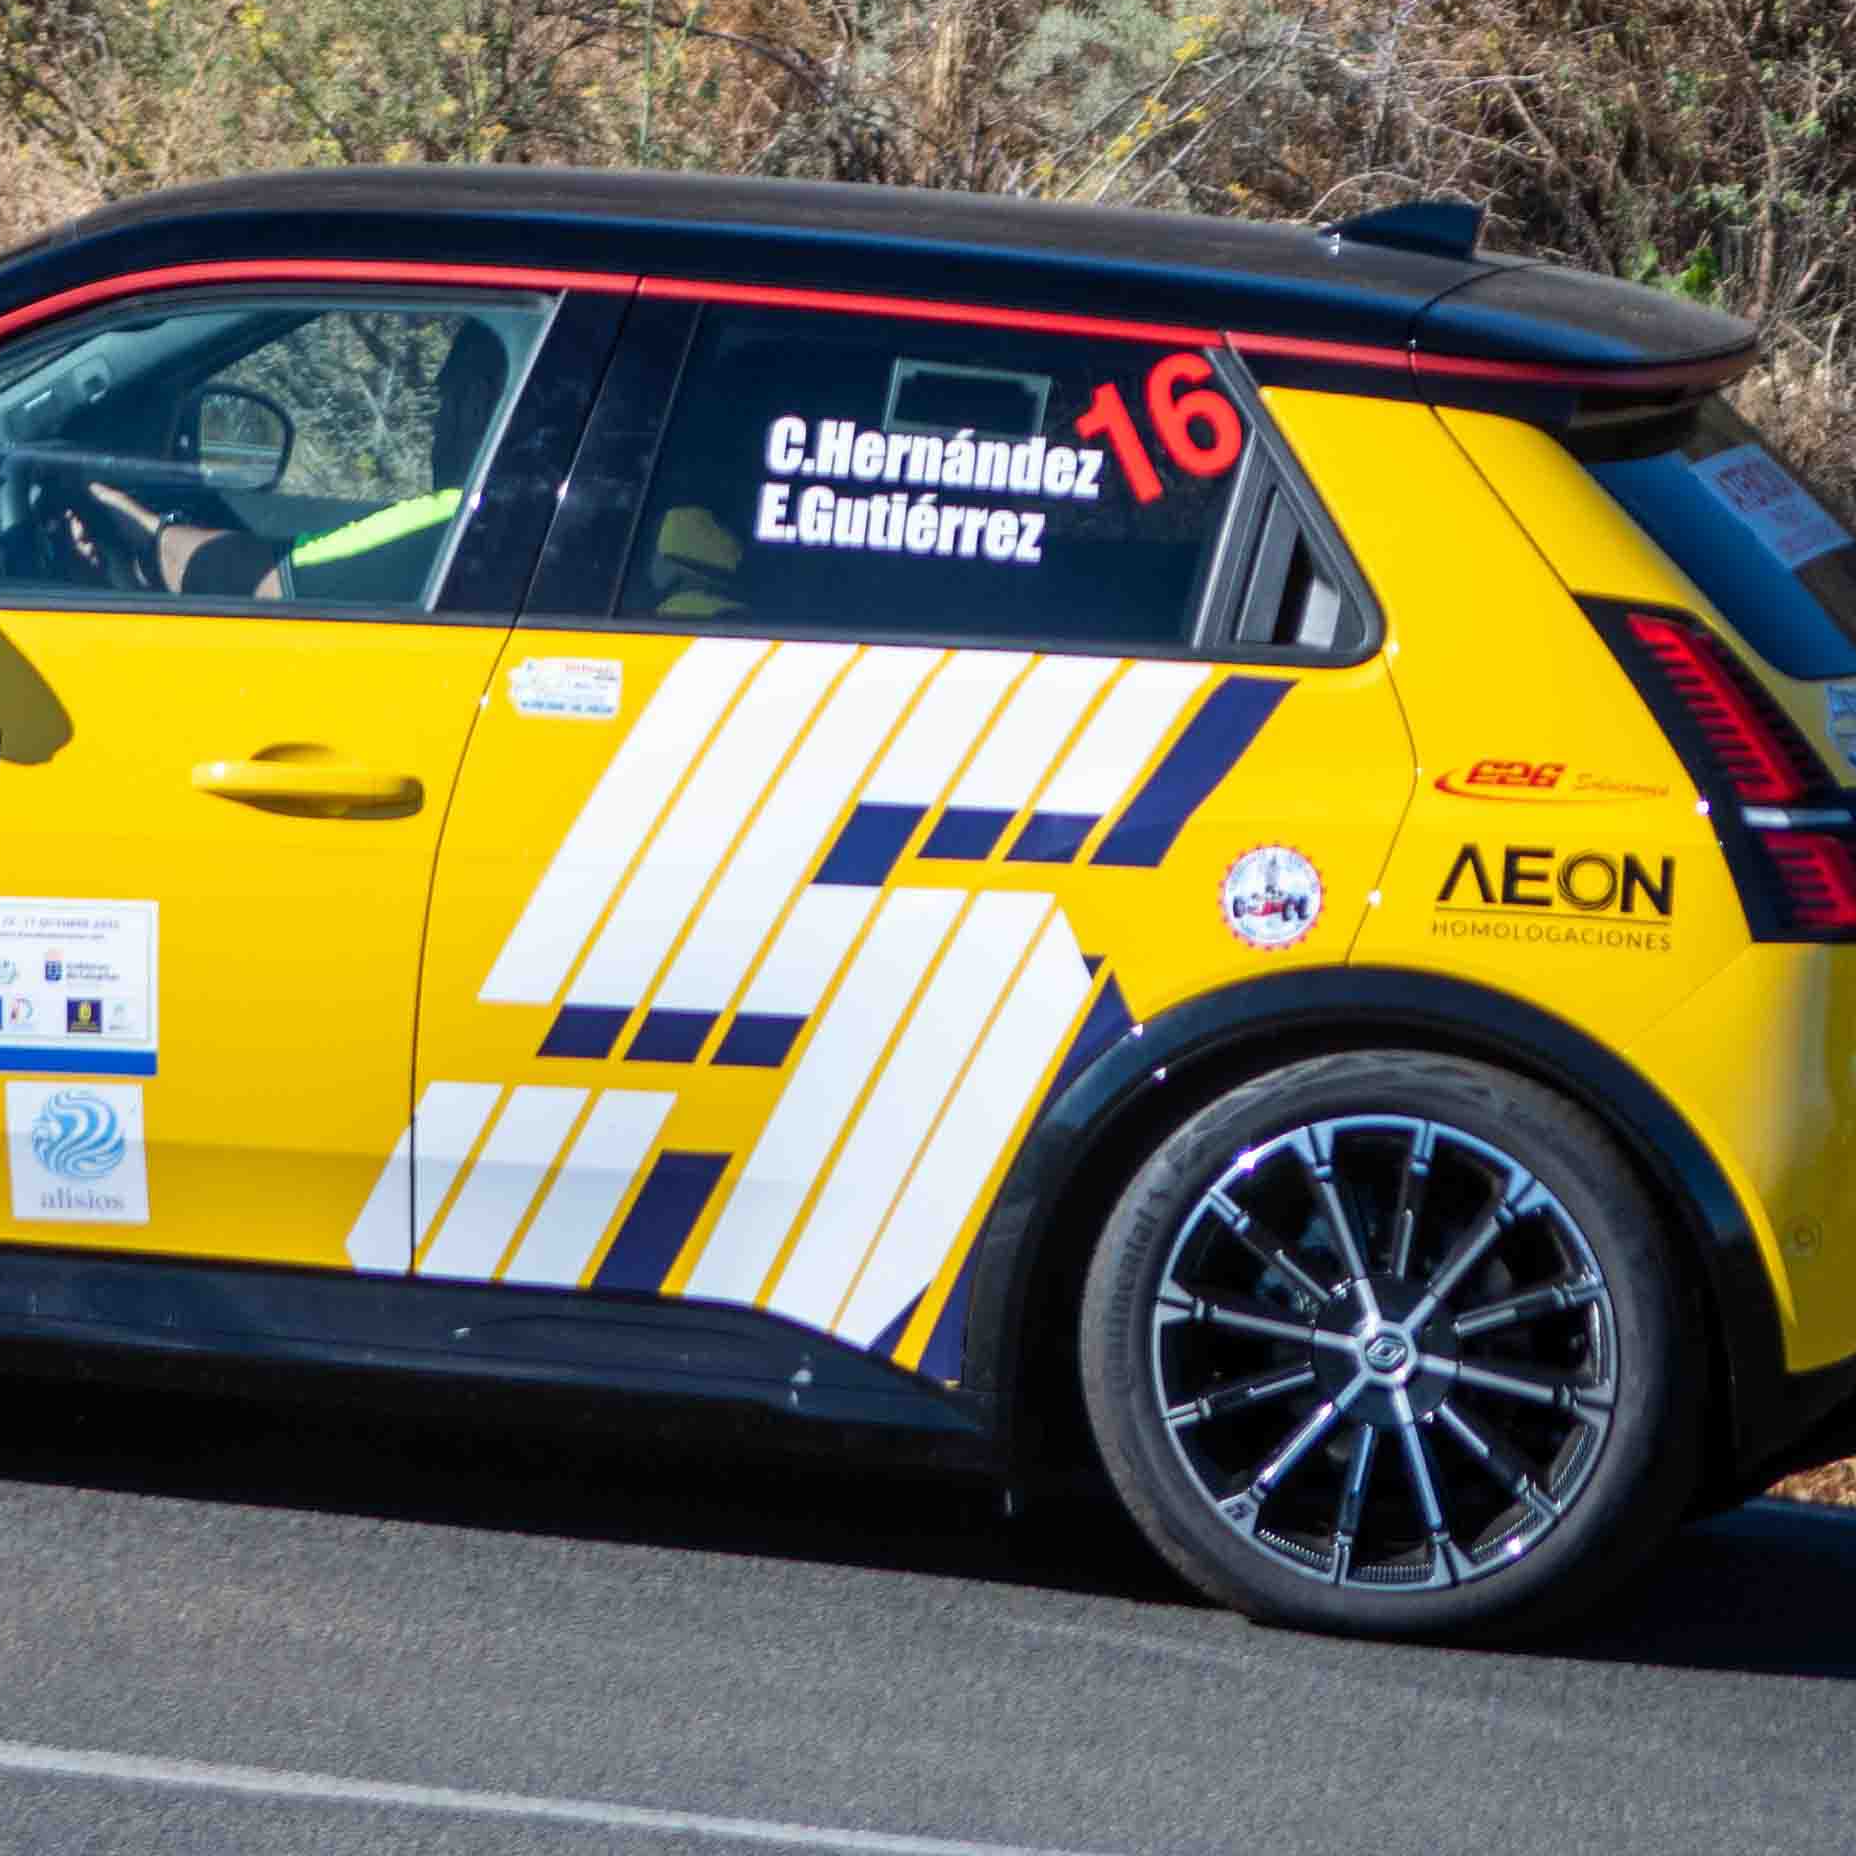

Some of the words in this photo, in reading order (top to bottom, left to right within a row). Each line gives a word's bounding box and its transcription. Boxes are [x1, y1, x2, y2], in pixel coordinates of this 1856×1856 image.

[766, 415, 1105, 500] C.Hernández
[1074, 352, 1242, 504] 16
[754, 481, 1047, 563] E.Gutiérrez
[1436, 842, 1676, 917] AEON
[1432, 919, 1671, 952] HOMOLOGACIONES
